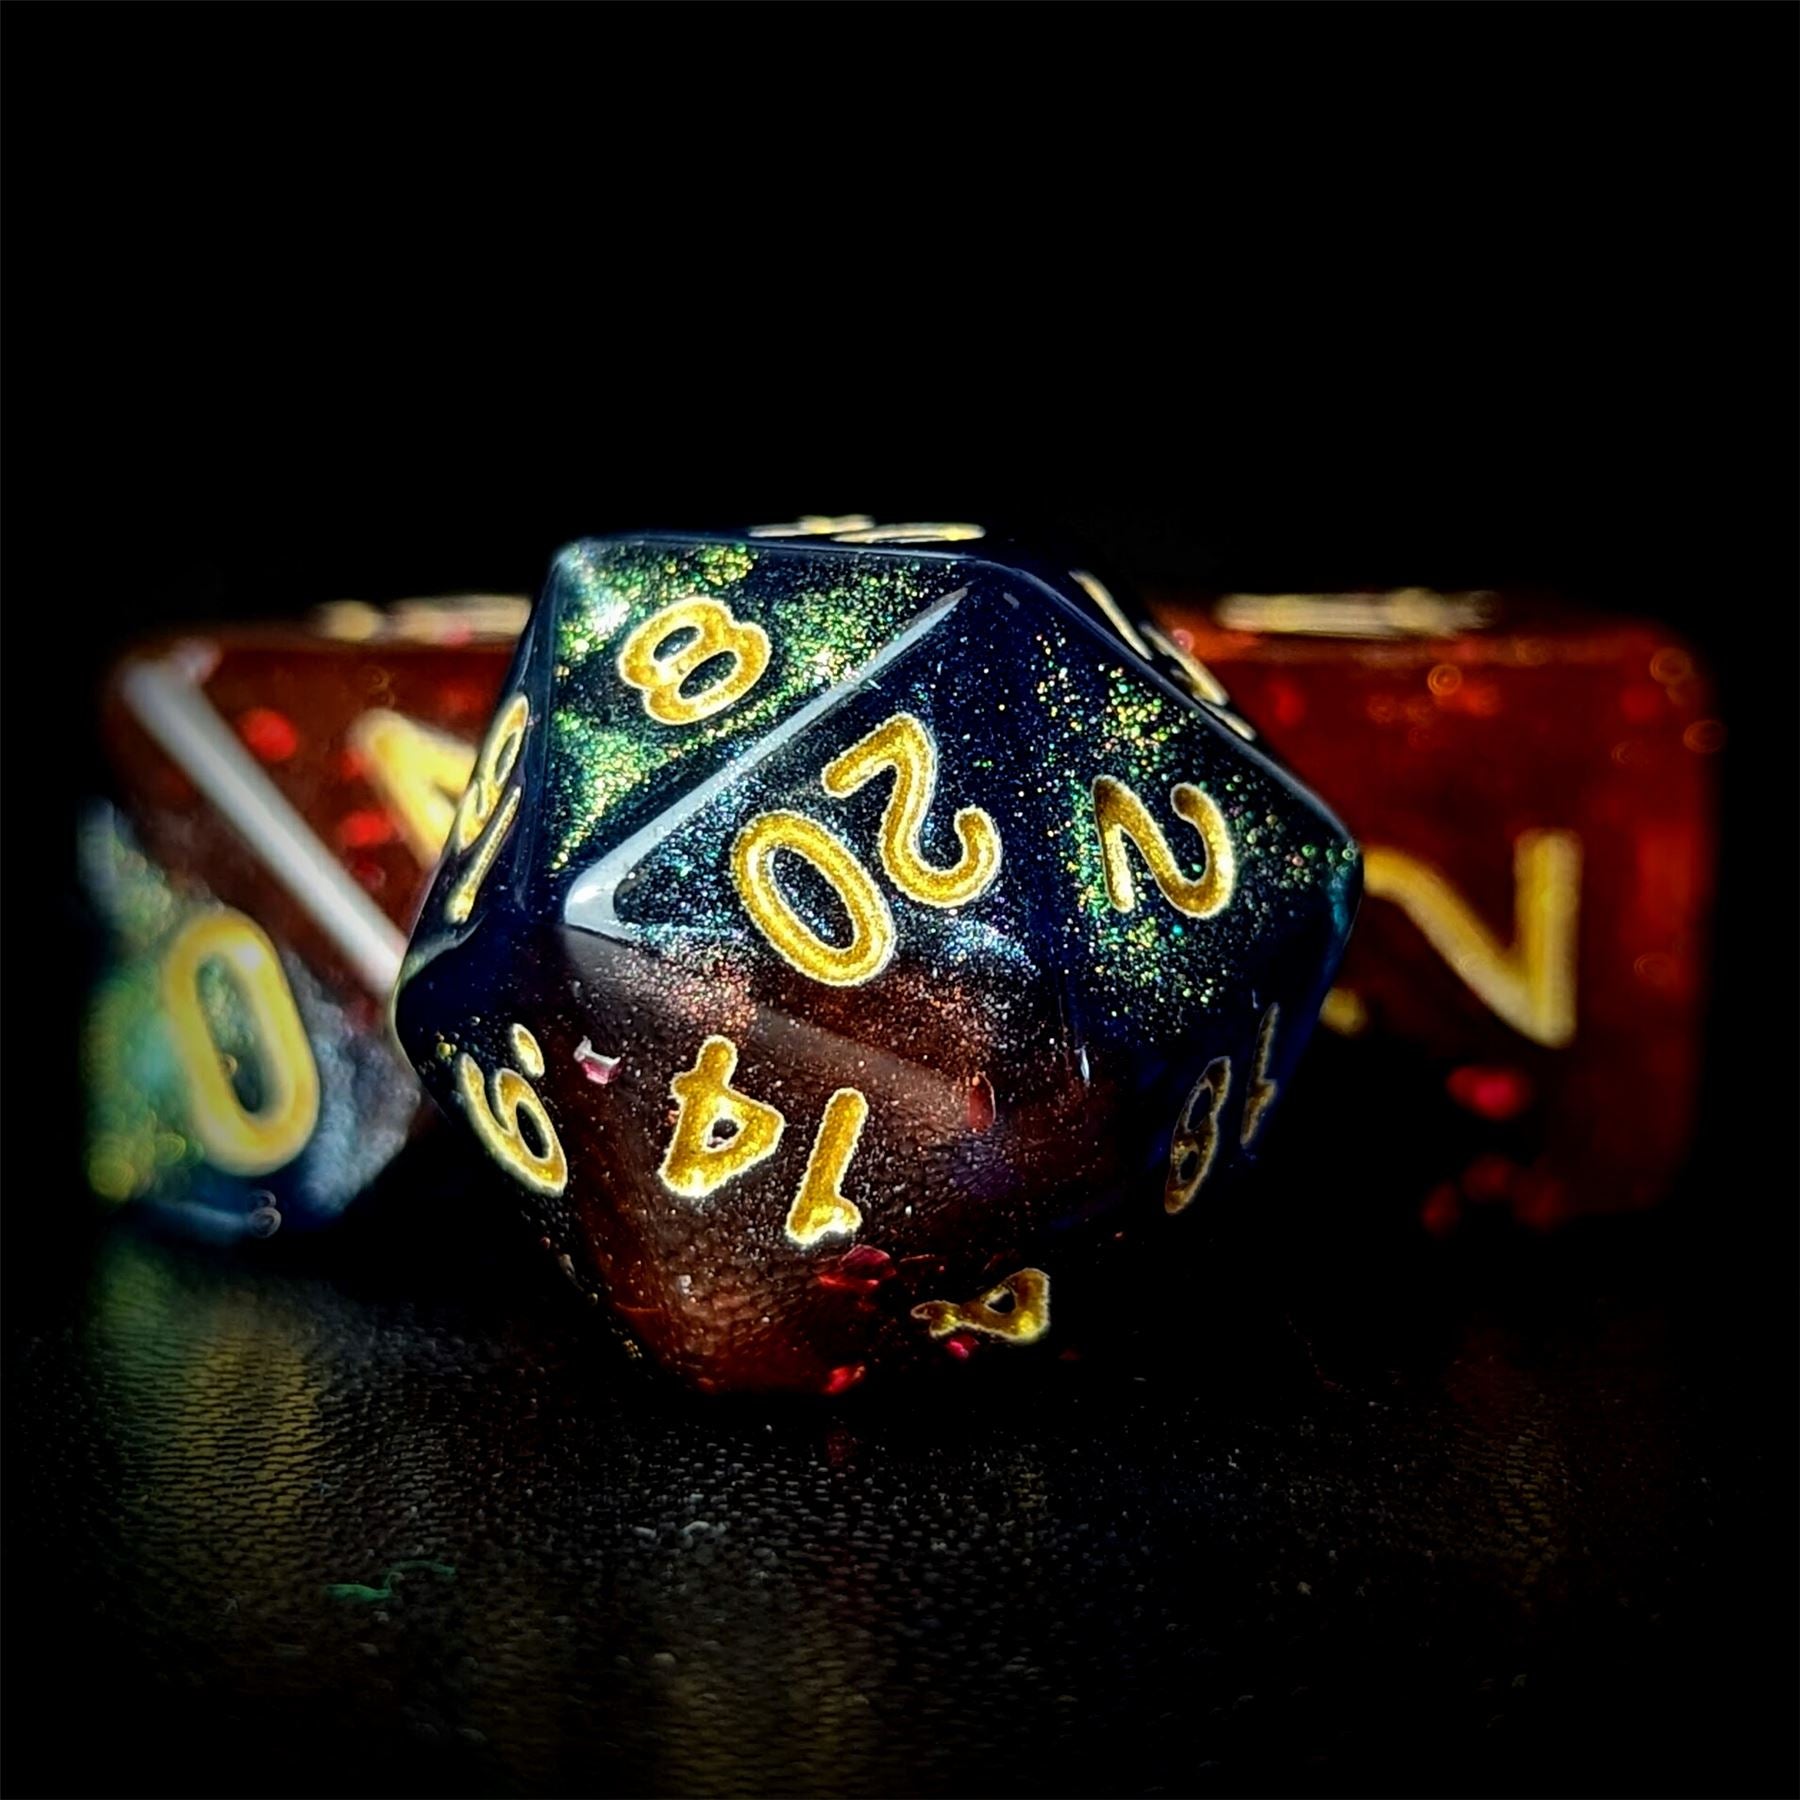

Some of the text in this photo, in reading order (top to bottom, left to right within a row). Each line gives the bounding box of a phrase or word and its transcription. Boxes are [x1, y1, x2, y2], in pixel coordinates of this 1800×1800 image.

[618, 596, 772, 727] 8
[730, 711, 1003, 988] 20
[1091, 774, 1237, 920] 2
[659, 1034, 868, 1248] 14
[1163, 1000, 1281, 1216] 18
